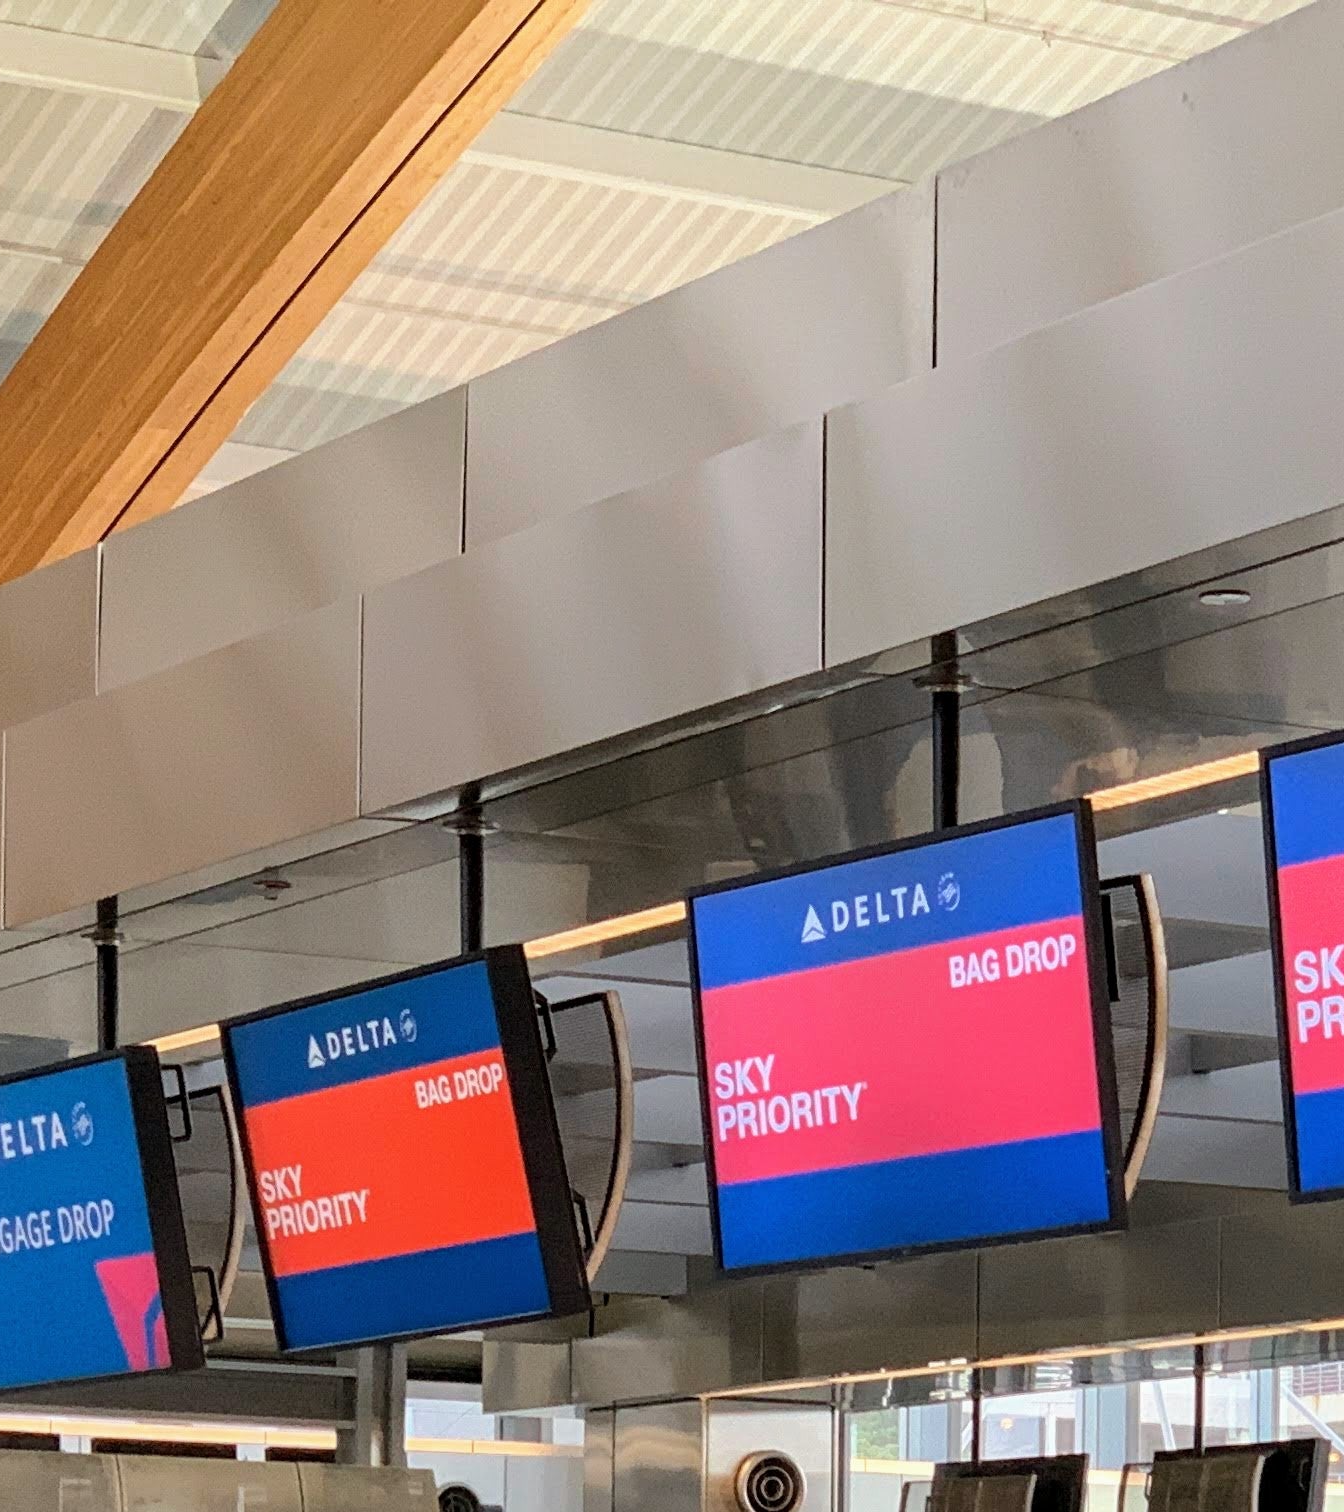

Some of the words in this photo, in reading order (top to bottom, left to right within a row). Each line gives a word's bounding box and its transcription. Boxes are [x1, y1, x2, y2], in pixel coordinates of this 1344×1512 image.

[830, 882, 930, 932] DELTA
[948, 948, 999, 988] BAG
[1004, 933, 1077, 977] DROP
[326, 1017, 396, 1060] DELTA
[415, 1074, 453, 1110] BAG
[455, 1062, 503, 1101] DROP
[714, 1054, 775, 1100] SKY
[719, 1083, 864, 1141] PRIORITY
[260, 1164, 302, 1205] SKY
[57, 1199, 114, 1245] DROP
[266, 1189, 369, 1240] PRIORITY
